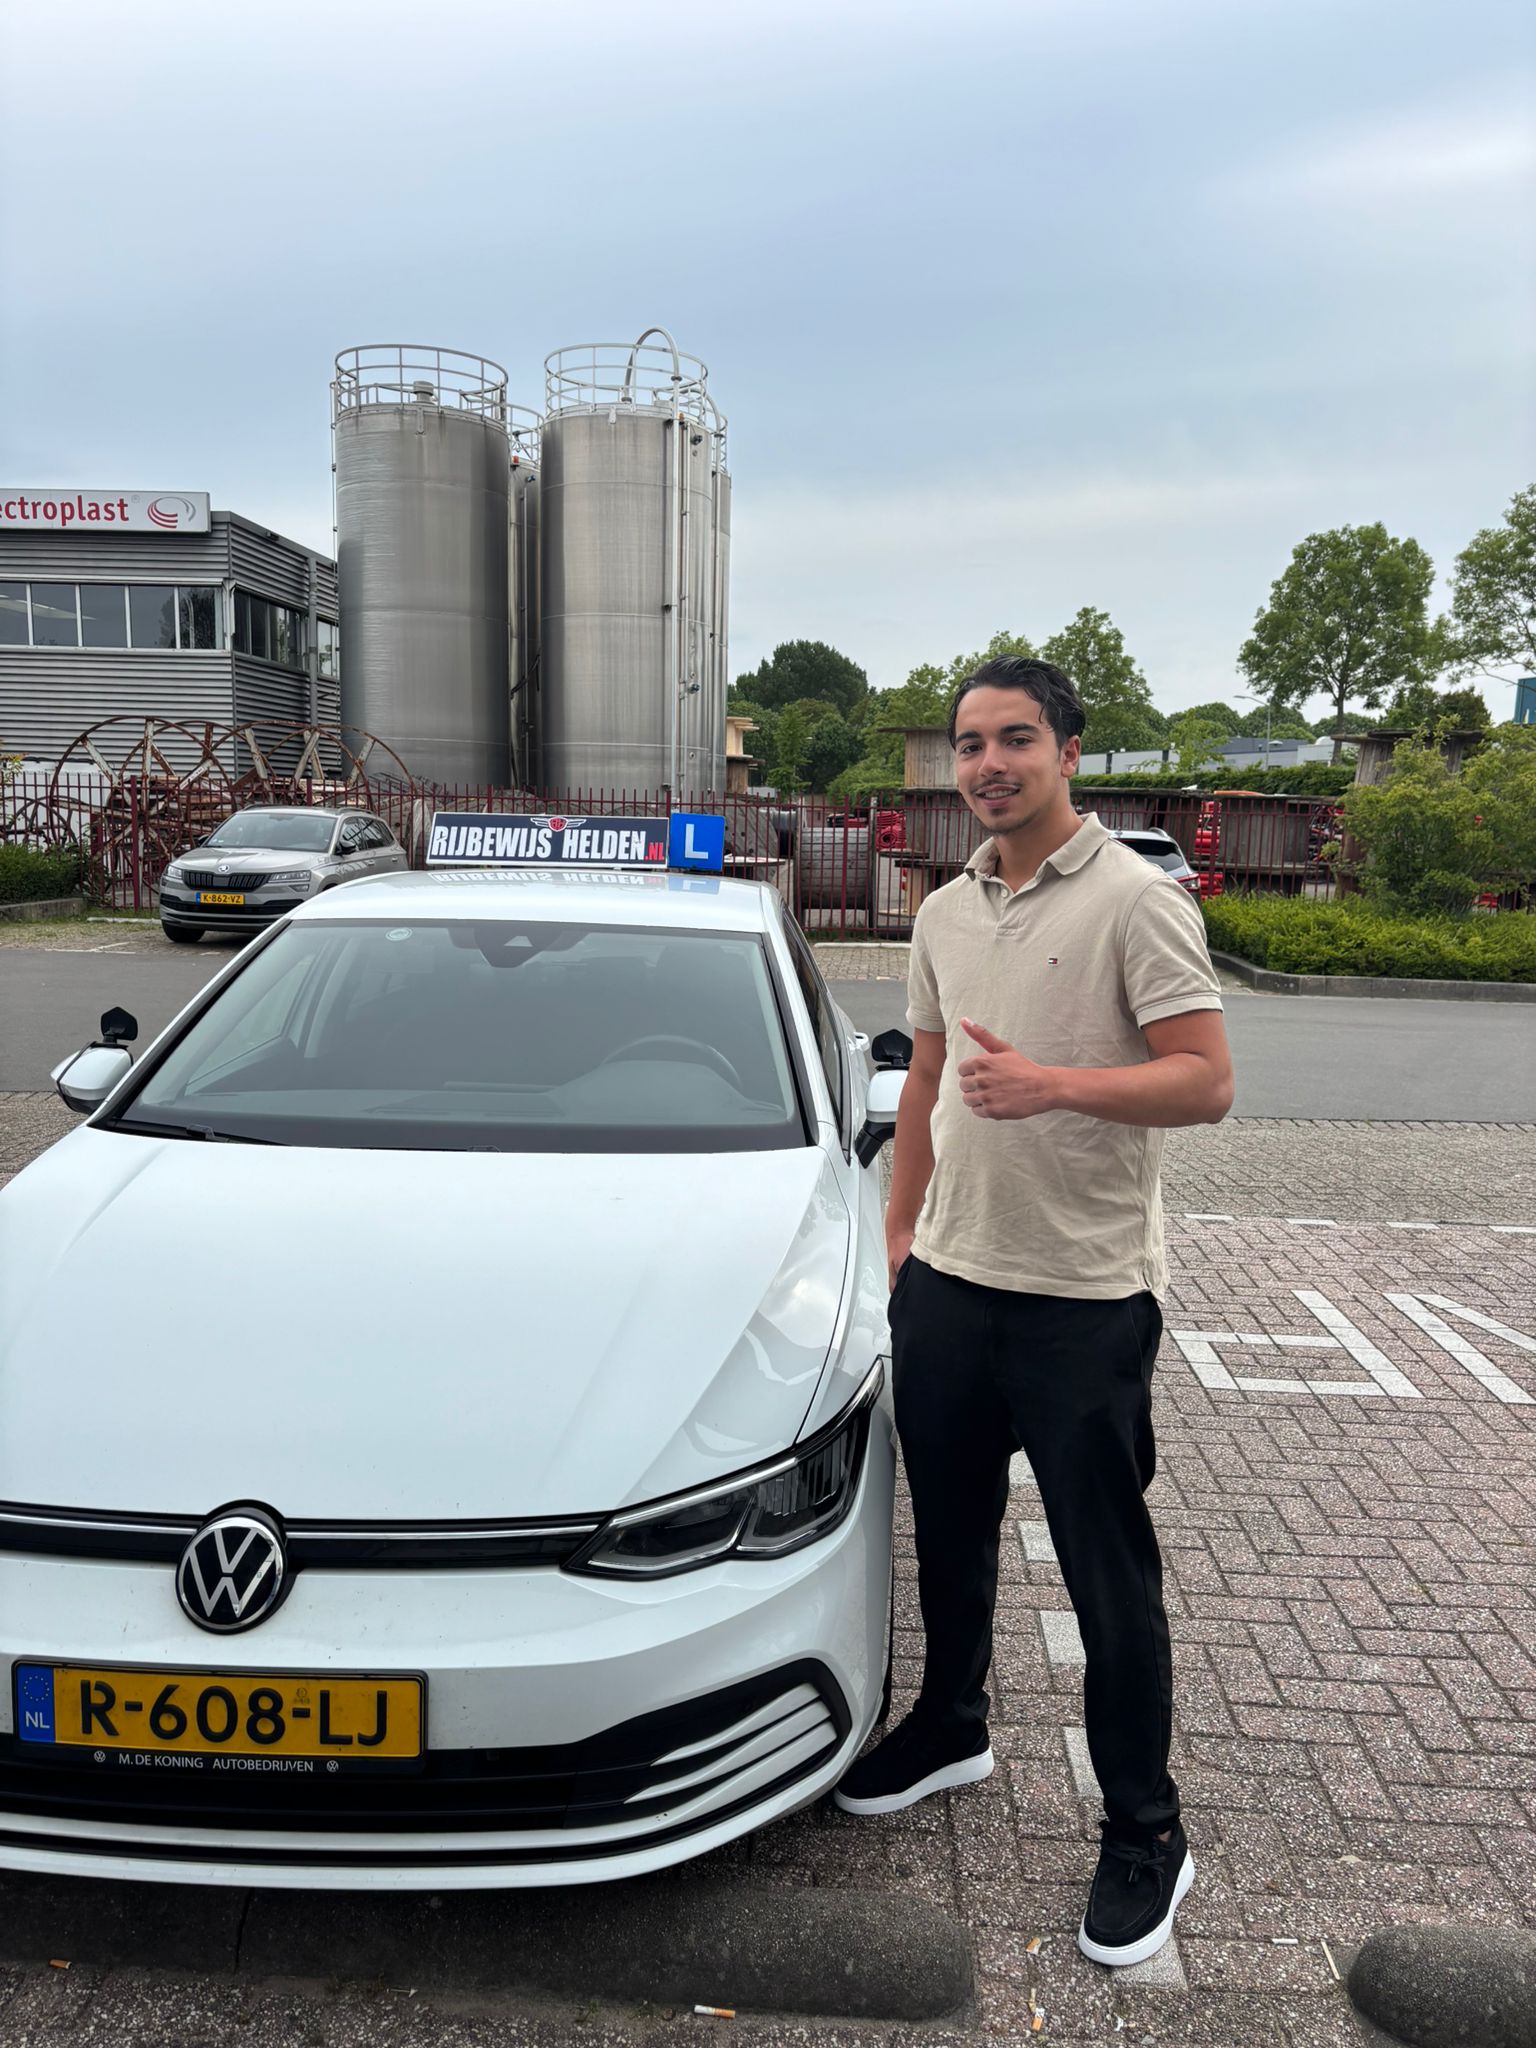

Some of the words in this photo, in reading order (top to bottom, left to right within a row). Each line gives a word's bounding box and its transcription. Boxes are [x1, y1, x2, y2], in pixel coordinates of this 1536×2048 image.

[0, 495, 129, 527] ctroplast
[431, 826, 553, 859] RIJBEWIJS
[684, 823, 709, 860] L
[203, 894, 241, 903] K-862-VZ
[25, 1710, 50, 1729] NL
[79, 1678, 389, 1747] R-608-LJ
[154, 1756, 204, 1769] KONING
[212, 1758, 314, 1773] AUTOBEDRIJVEN
